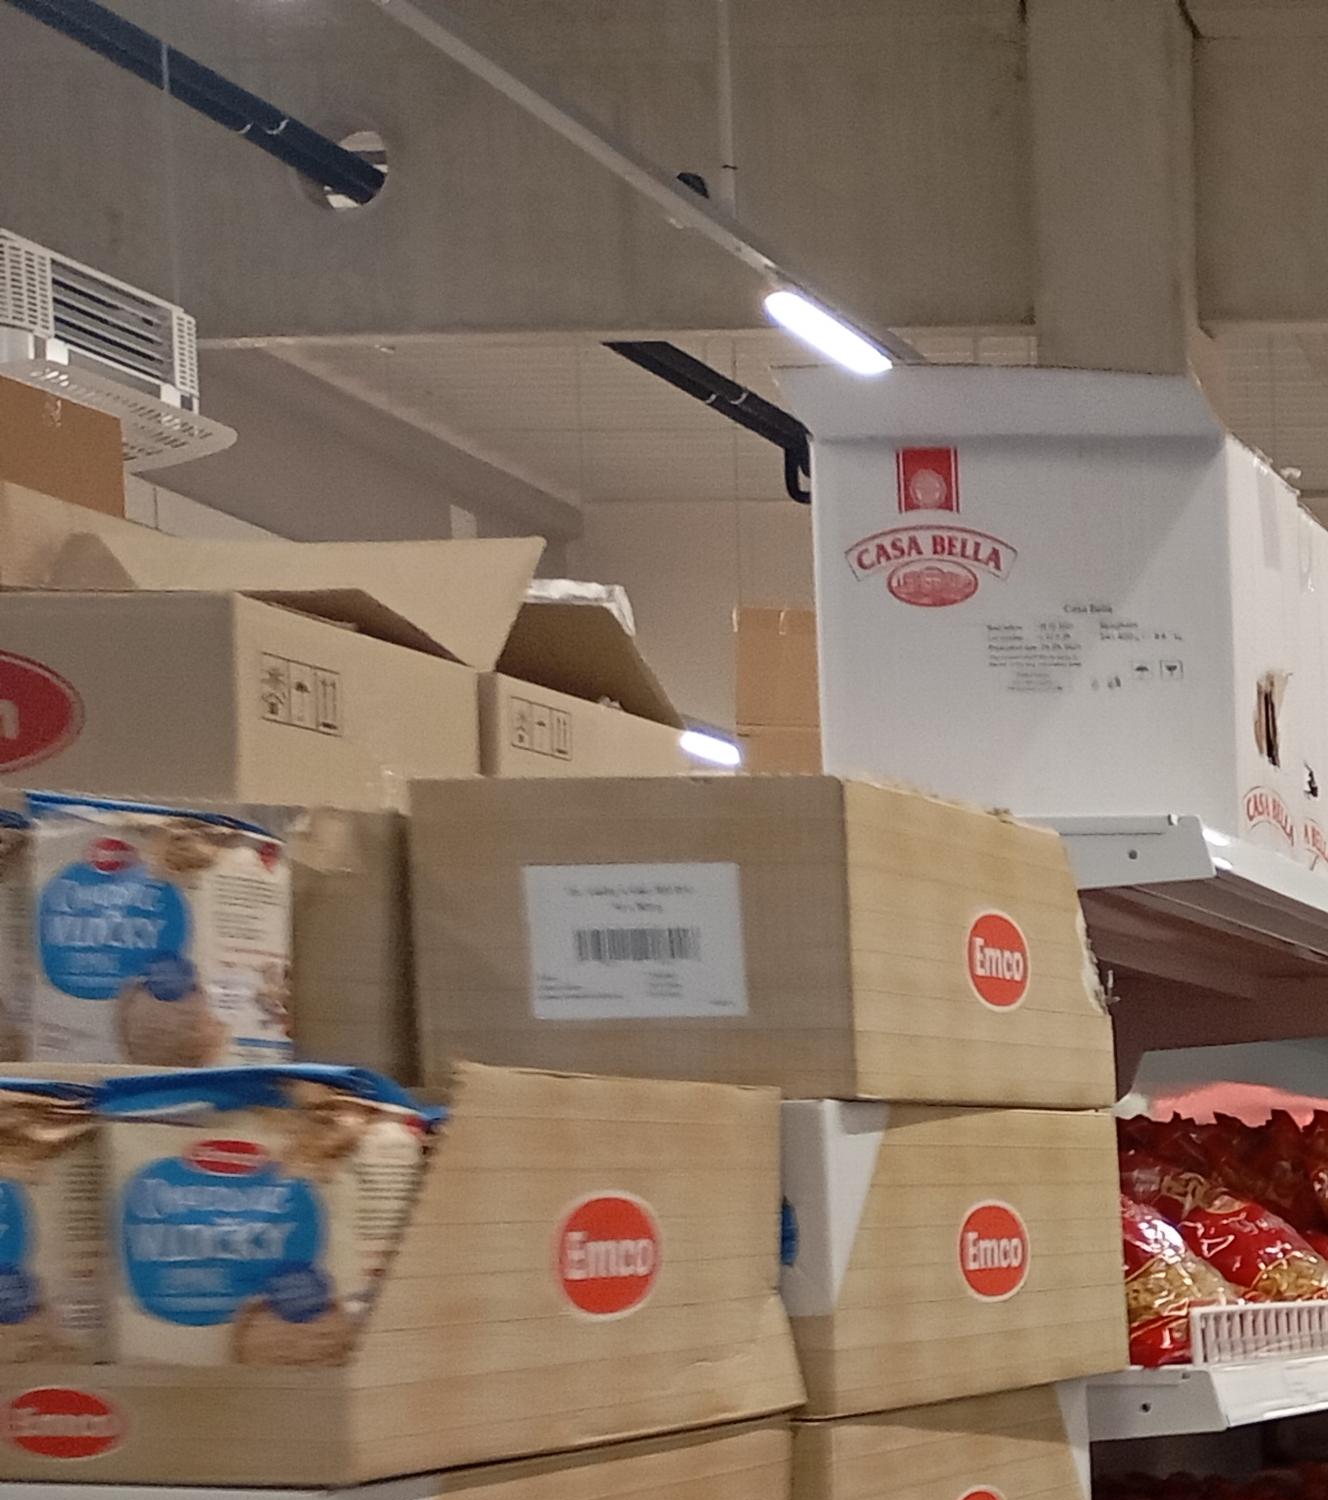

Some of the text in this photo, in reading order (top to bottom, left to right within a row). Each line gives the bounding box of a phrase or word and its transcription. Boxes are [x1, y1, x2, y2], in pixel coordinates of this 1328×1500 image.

[857, 535, 1002, 571] CASA BELLA
[1246, 793, 1270, 821] CASA
[1272, 797, 1294, 847] BELLA
[972, 936, 1025, 982] Emco
[565, 1230, 655, 1280] Emco
[965, 1231, 1023, 1271] Emco
